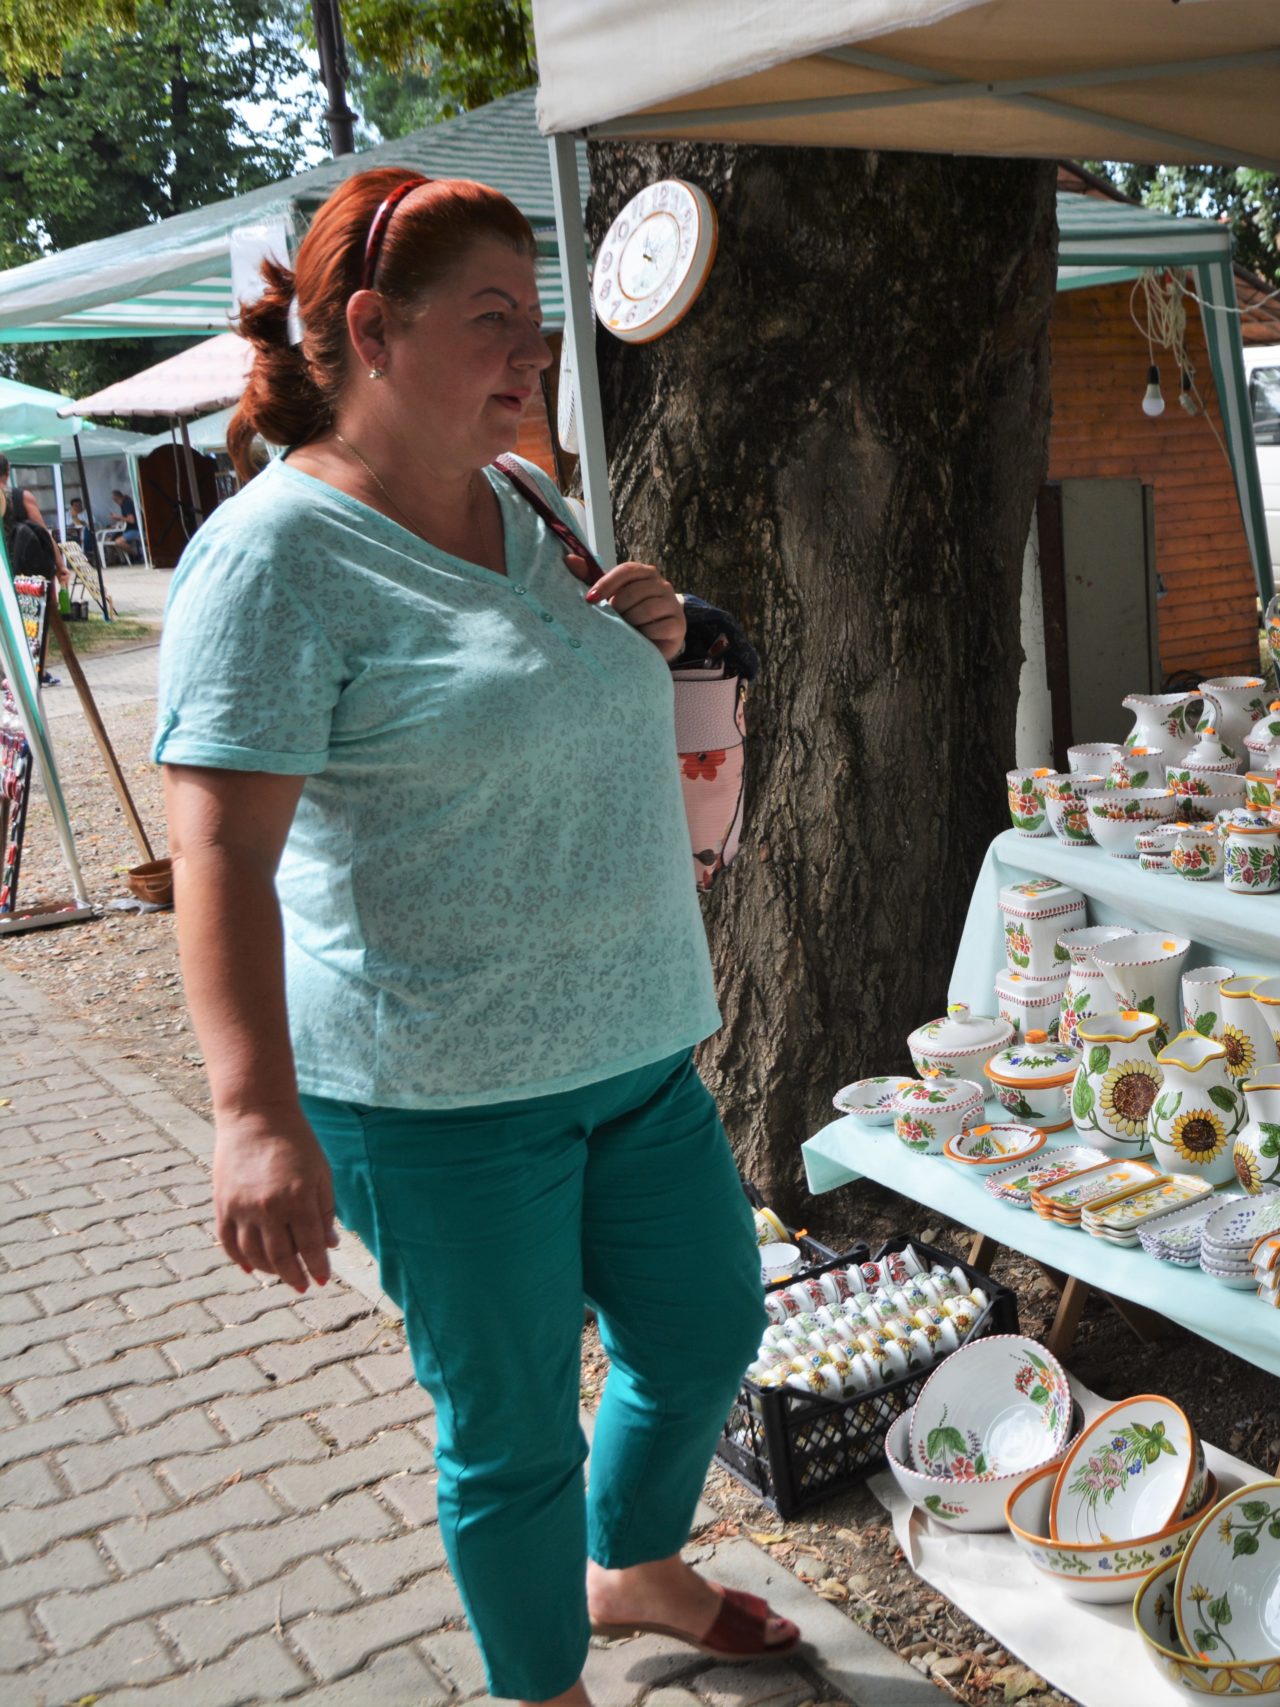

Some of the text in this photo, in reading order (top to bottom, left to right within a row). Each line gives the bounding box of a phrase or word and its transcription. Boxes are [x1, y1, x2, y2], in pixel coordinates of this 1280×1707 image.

[652, 184, 669, 208] 12
[611, 219, 629, 245] 10
[601, 251, 613, 273] 9
[599, 278, 611, 301] 8
[608, 299, 622, 321] 7
[625, 304, 638, 325] 6
